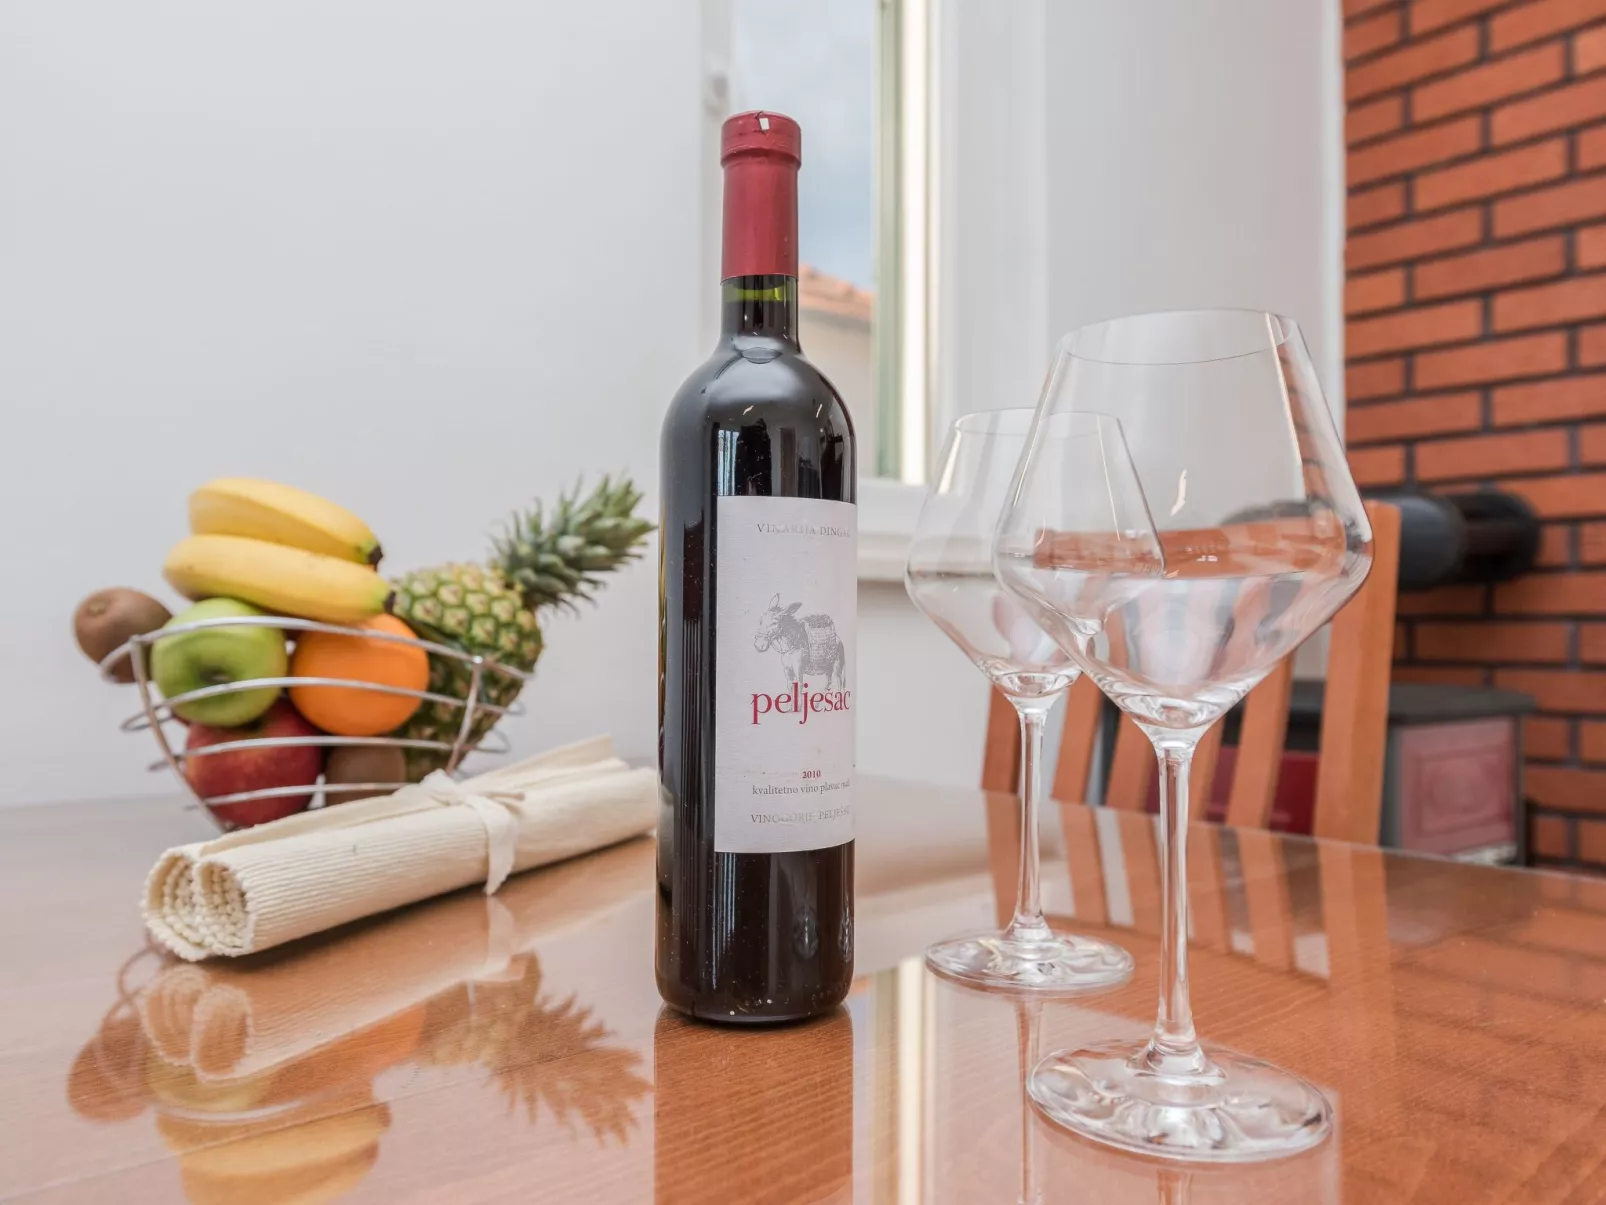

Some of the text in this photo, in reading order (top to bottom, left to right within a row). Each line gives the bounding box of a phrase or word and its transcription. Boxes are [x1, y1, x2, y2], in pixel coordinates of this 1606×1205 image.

[757, 523, 816, 535] VINARIJA
[750, 682, 851, 725] pelješac
[802, 769, 821, 779] 2010
[752, 784, 799, 795] kvalitetno
[800, 783, 819, 793] vino
